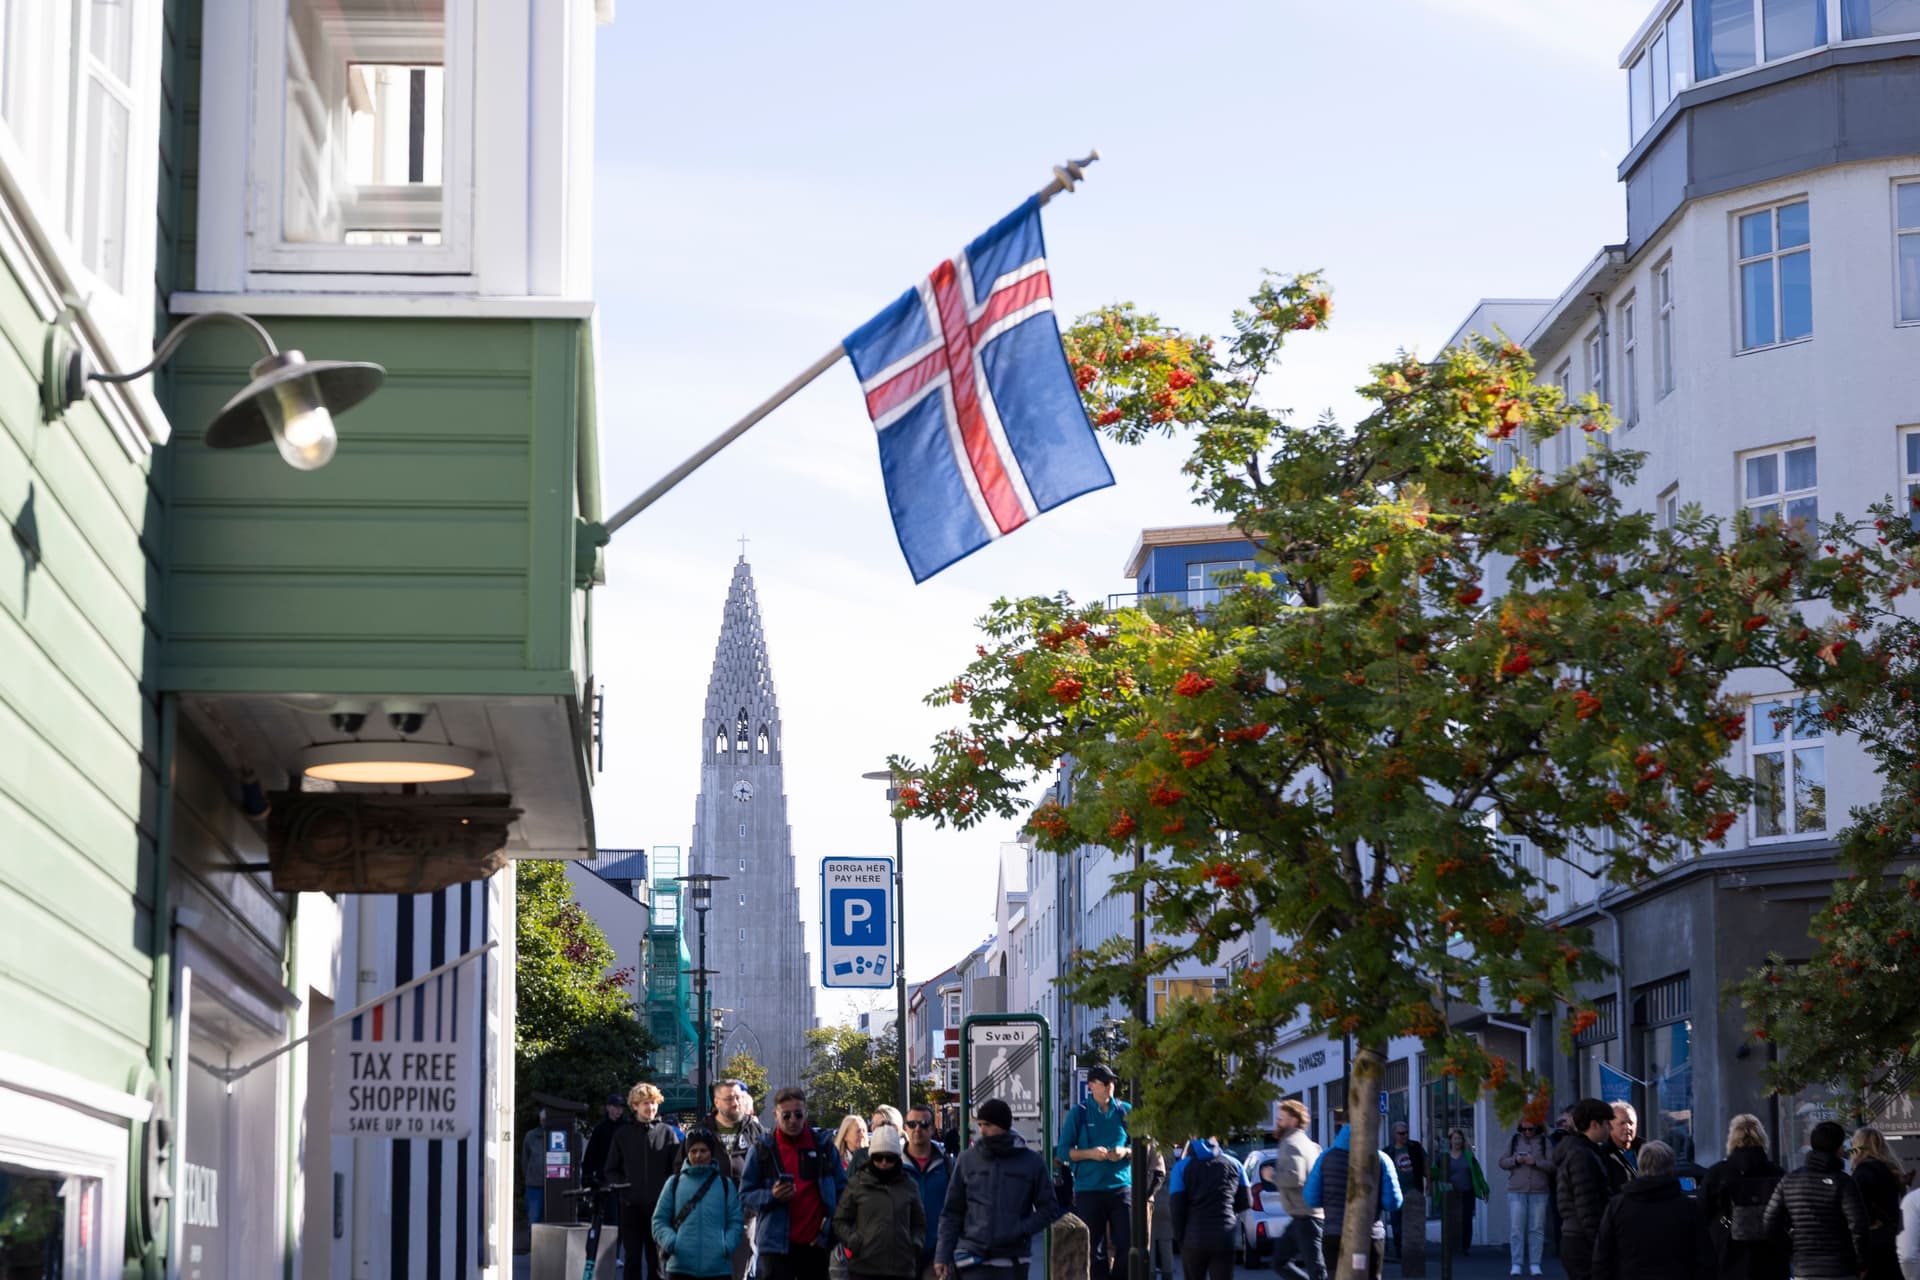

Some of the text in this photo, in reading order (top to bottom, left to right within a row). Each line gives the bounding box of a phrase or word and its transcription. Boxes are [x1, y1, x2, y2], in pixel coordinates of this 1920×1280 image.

[829, 864, 863, 872] BORGA
[844, 898, 872, 936] P
[866, 923, 872, 934] 1
[985, 1031, 1025, 1041] Svæði
[350, 1052, 457, 1081] TAX FREE
[349, 1086, 456, 1112] SHOPPING
[349, 1117, 455, 1132] SAVE UP TO 14%
